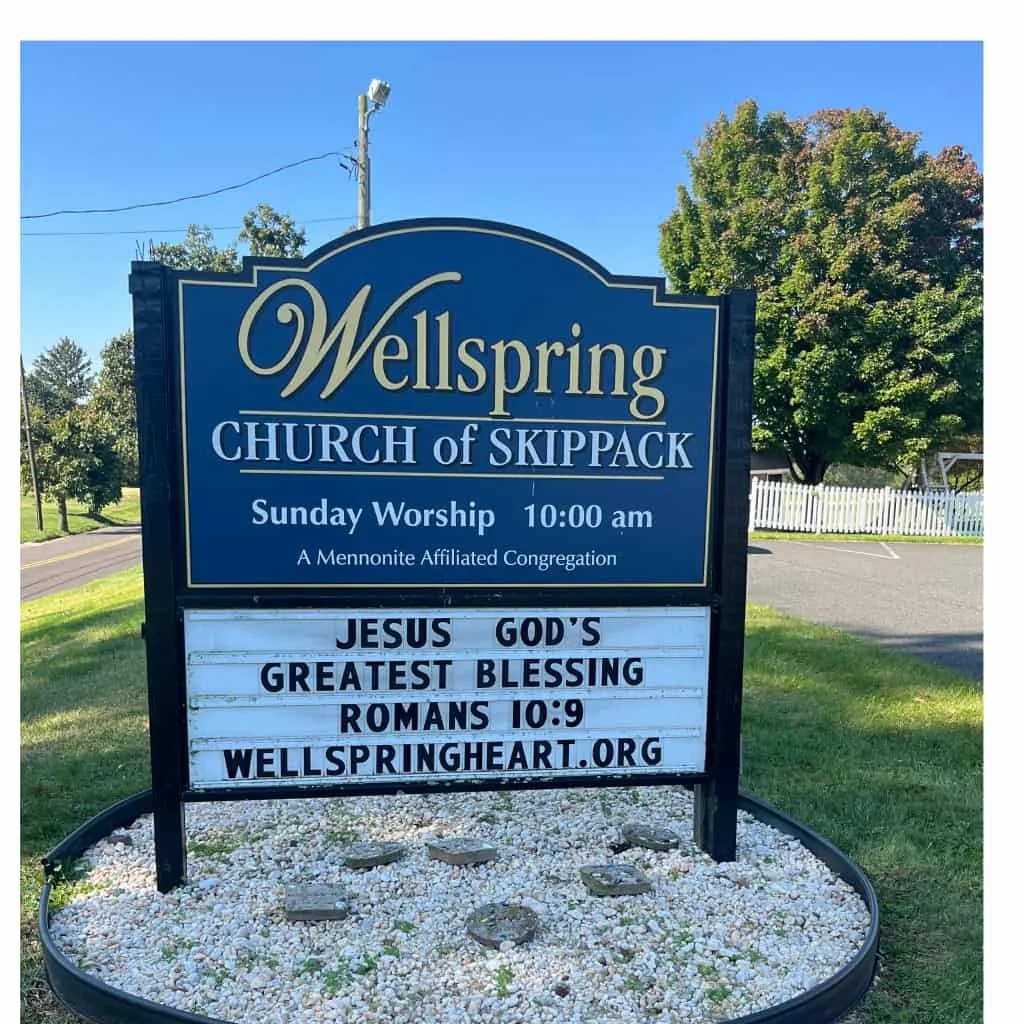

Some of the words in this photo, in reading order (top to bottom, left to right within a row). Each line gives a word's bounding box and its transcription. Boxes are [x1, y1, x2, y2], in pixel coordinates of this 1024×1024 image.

[237, 271, 667, 420] Wellspring
[211, 421, 417, 464] CHURCH
[433, 425, 478, 465] of
[489, 427, 693, 470] SKIPPACK
[251, 498, 363, 534] Sunday
[372, 501, 496, 536] Worship
[523, 502, 603, 529] 10:00
[611, 511, 653, 529] am
[297, 550, 311, 566] A
[316, 549, 415, 567] Mennonite
[420, 549, 498, 567] Affiliated
[503, 550, 617, 571] Congregation
[336, 618, 451, 650] JESUS
[495, 617, 602, 648] GOD'S
[260, 660, 452, 693] GREATEST
[477, 657, 644, 689] BLESSING
[340, 701, 490, 733] ROMANS
[512, 699, 585, 729] 10:9
[223, 737, 663, 779] WELLSPRINGHEART.ORG
